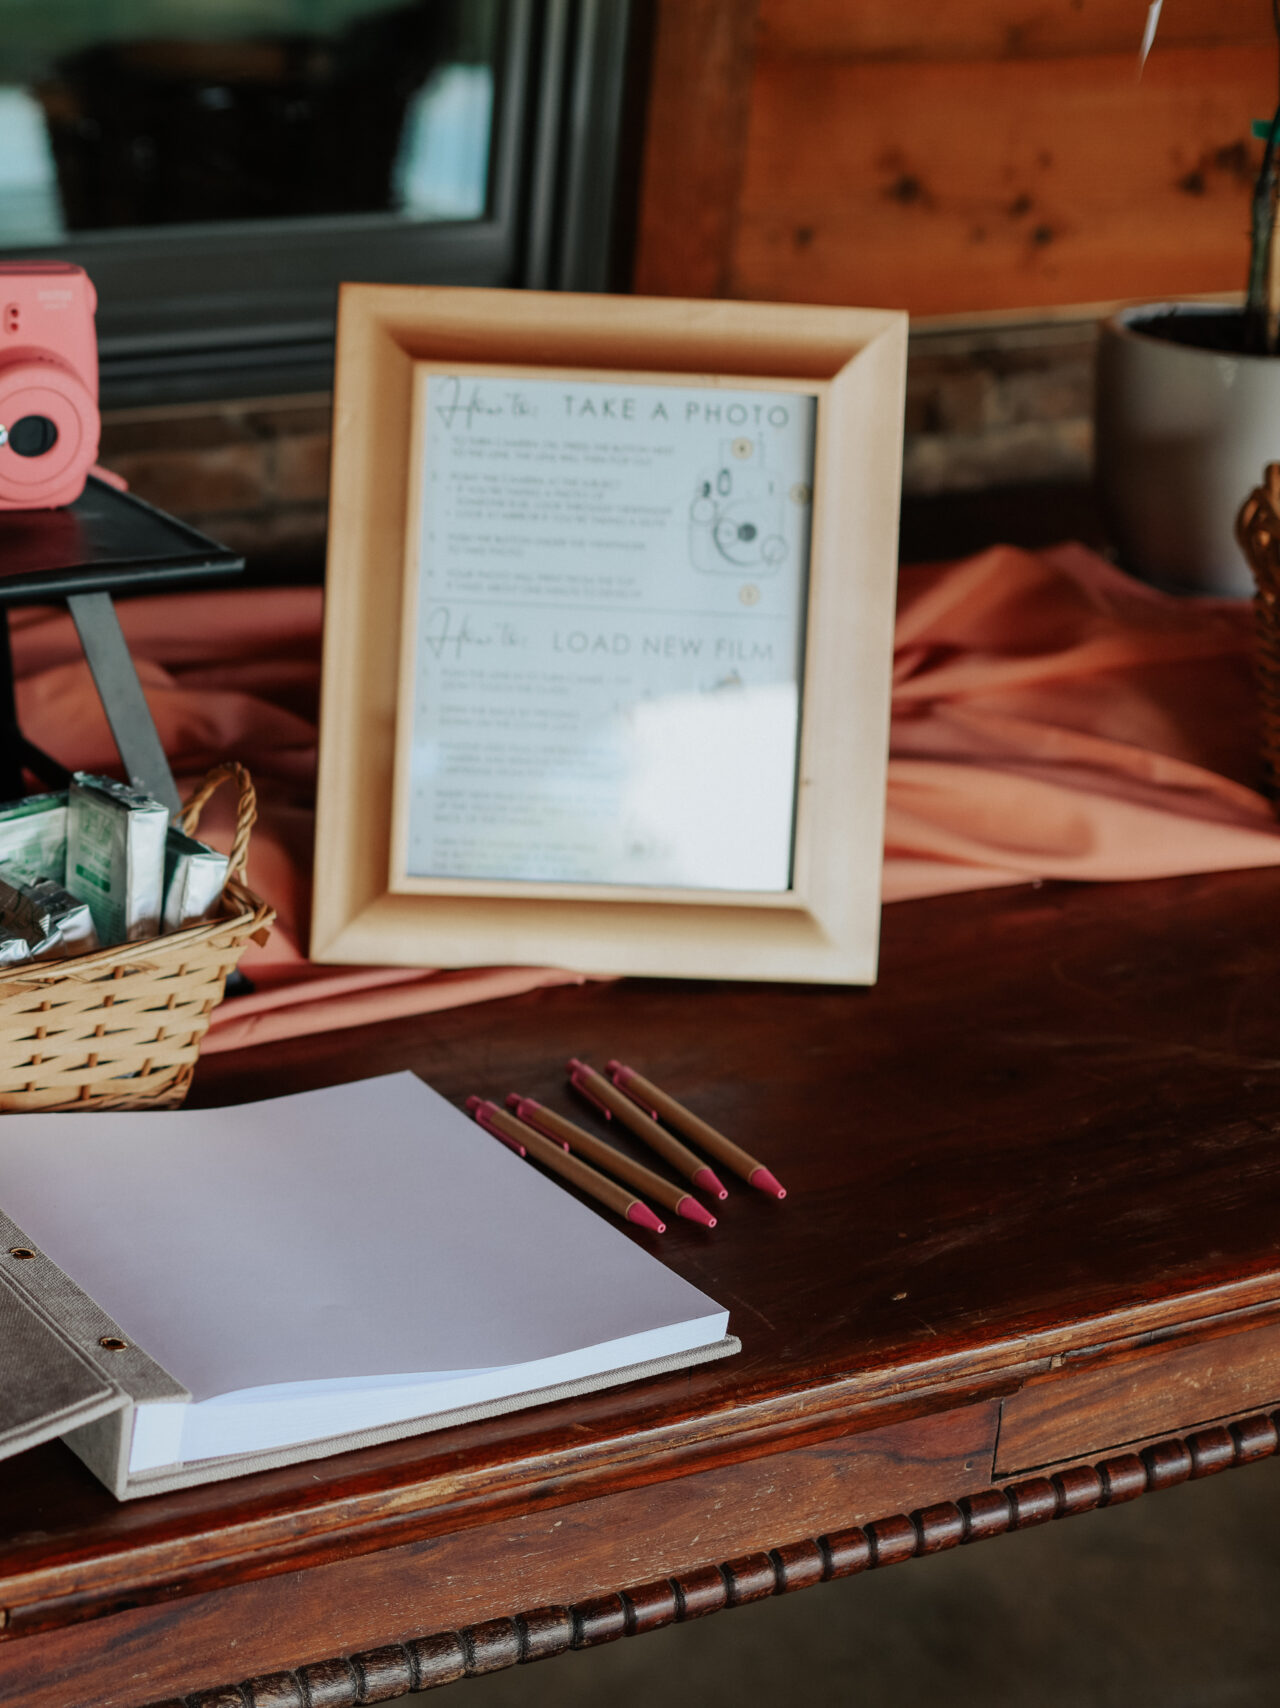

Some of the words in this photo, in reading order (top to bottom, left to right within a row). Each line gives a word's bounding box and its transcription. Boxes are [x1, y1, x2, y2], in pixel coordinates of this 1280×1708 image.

[563, 394, 635, 421] TAKE
[652, 403, 670, 422] A
[685, 403, 790, 429] PHOTO
[551, 630, 631, 655] LOAD
[643, 634, 703, 658] NEW
[715, 638, 773, 663] FILM
